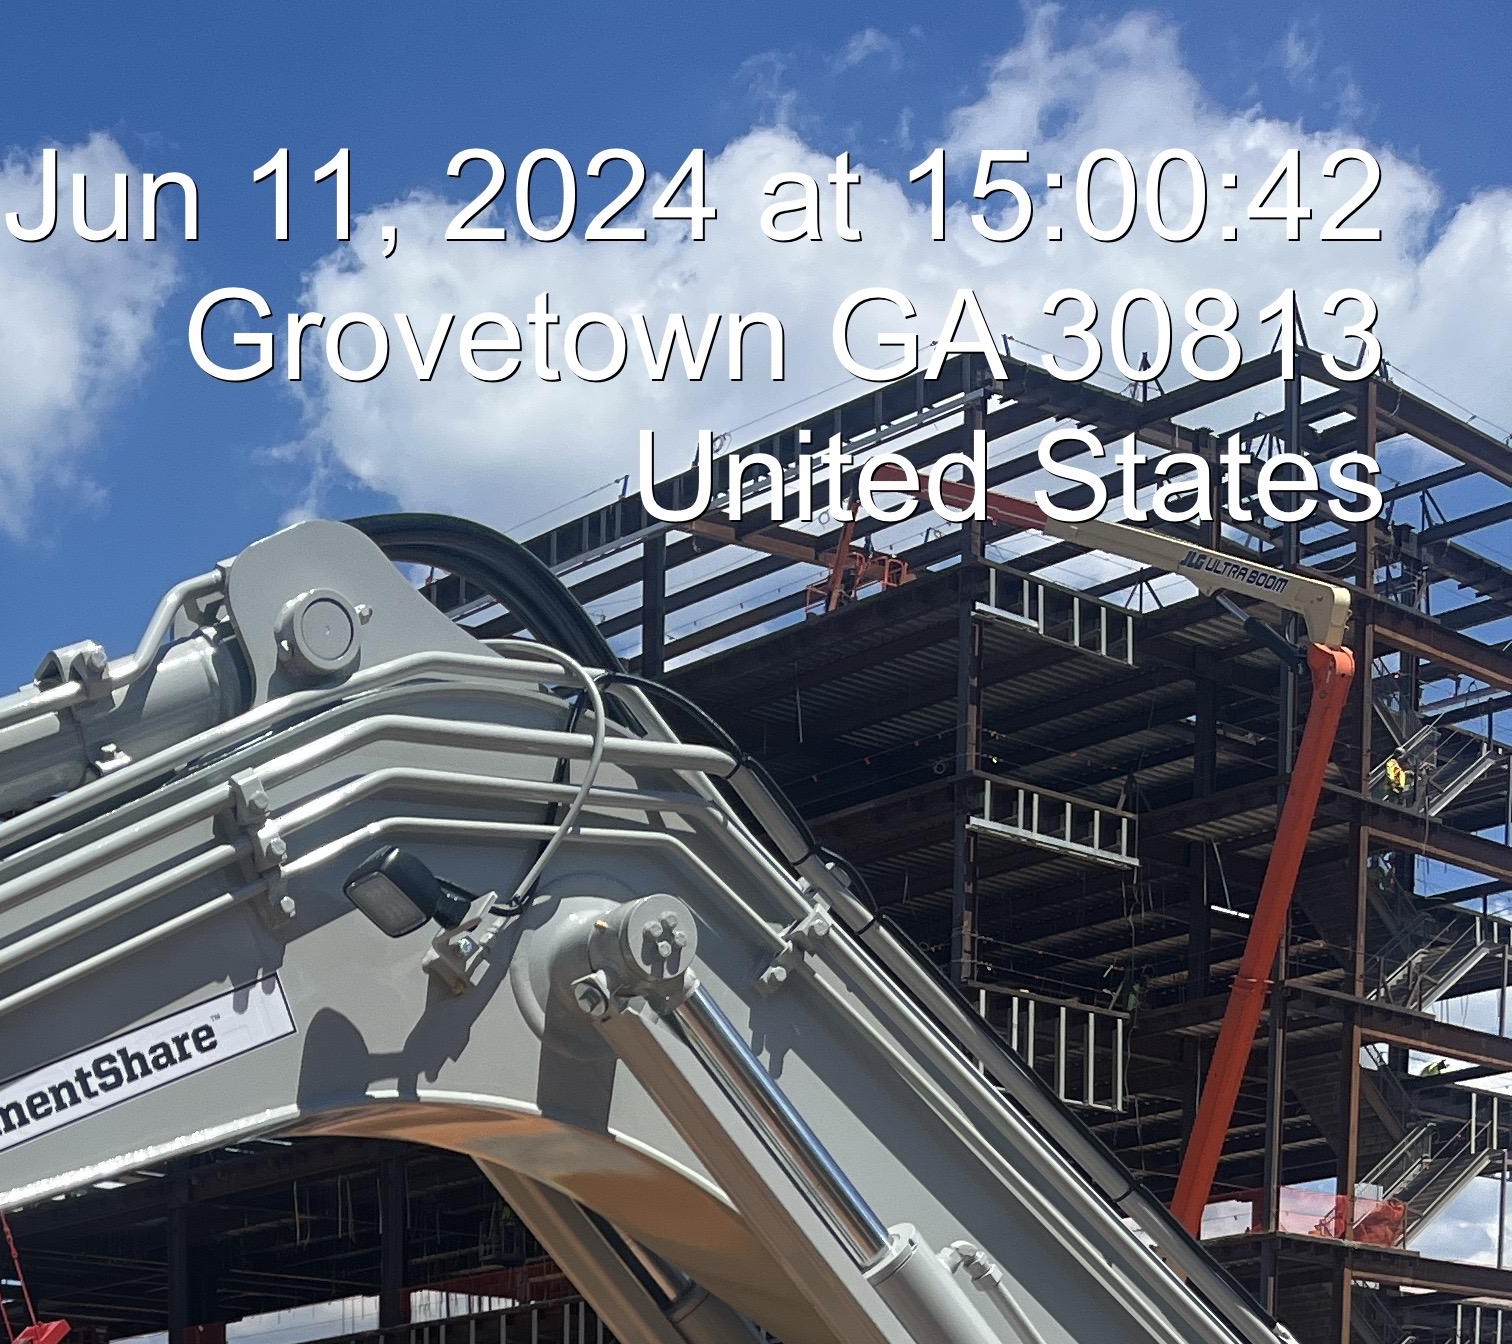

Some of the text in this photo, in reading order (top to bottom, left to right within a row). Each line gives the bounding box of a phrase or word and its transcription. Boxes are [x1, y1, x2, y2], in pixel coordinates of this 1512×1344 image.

[1180, 551, 1288, 593] JLG ULTRA BOOM
